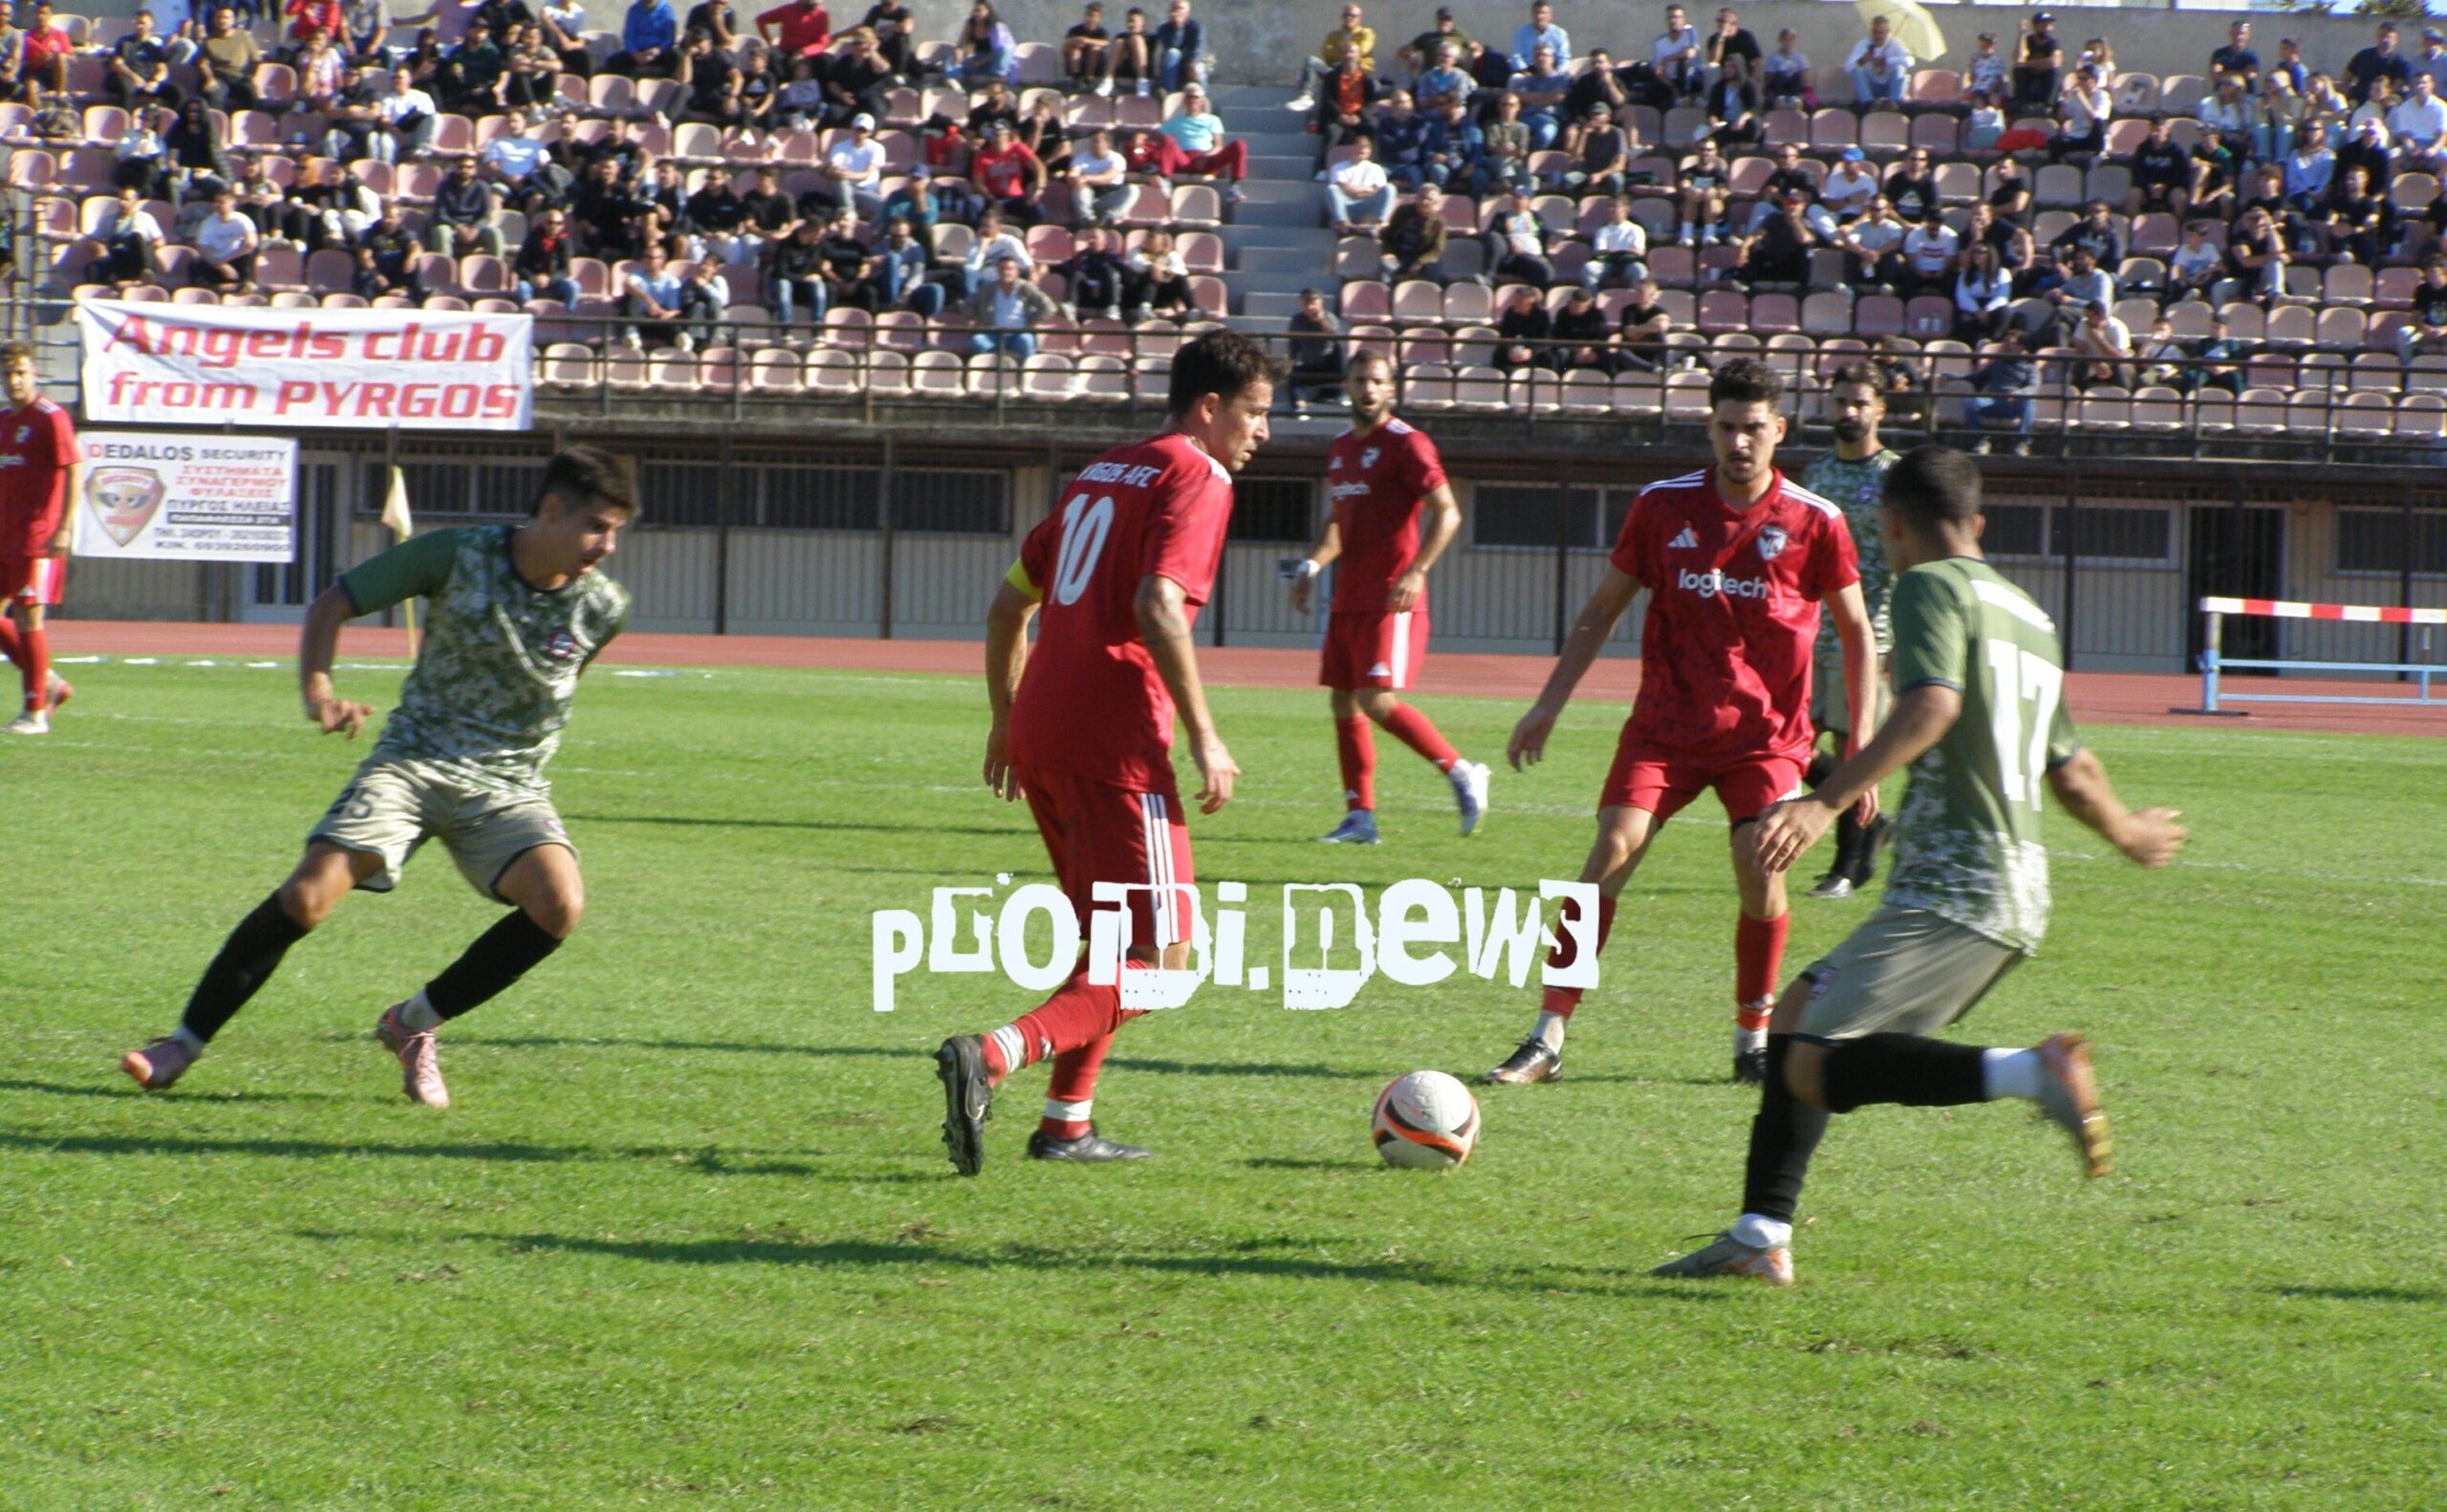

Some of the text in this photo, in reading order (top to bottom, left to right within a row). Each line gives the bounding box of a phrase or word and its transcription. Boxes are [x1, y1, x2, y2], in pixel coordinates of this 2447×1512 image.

[103, 313, 507, 369] Angels club
[108, 371, 521, 419] from PYRGOS
[87, 443, 286, 461] DEDALOS SECURITY
[176, 476, 286, 486] ΣΥΝΑΓΕΡΜΟΥ
[183, 465, 283, 475] ΣΥΣΤΗΜΑΤΑ
[167, 499, 227, 511] ΠΥΡΓΟΣ
[1050, 493, 1115, 606] 10
[1678, 568, 1768, 599] logitech
[1986, 638, 2064, 811] 17
